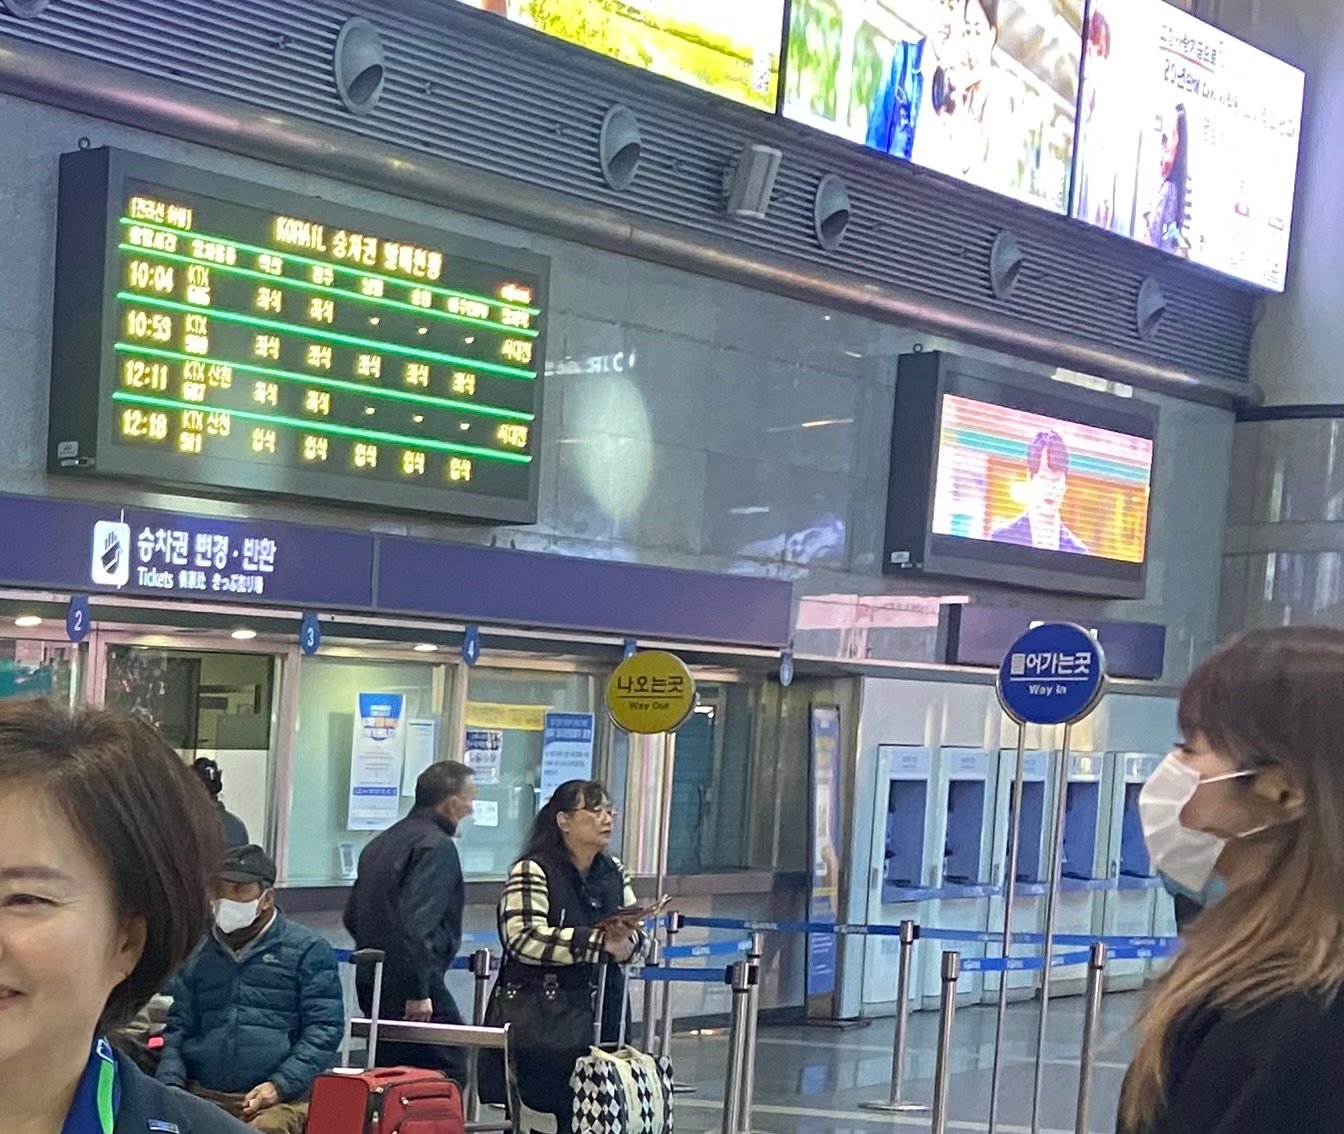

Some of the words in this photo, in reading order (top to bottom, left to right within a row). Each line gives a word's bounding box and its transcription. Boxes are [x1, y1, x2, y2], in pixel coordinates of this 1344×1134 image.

[332, 229, 377, 266] 승차권
[130, 260, 174, 293] 10:04
[188, 265, 210, 286] KTX
[185, 314, 208, 335] KTX
[125, 359, 168, 391] 12:11
[136, 526, 189, 565] 승차권
[137, 566, 174, 588] Tickets
[74, 611, 82, 630] 2
[307, 627, 315, 646] 3
[617, 675, 684, 694] 나오는곳
[1029, 684, 1052, 696] Way
